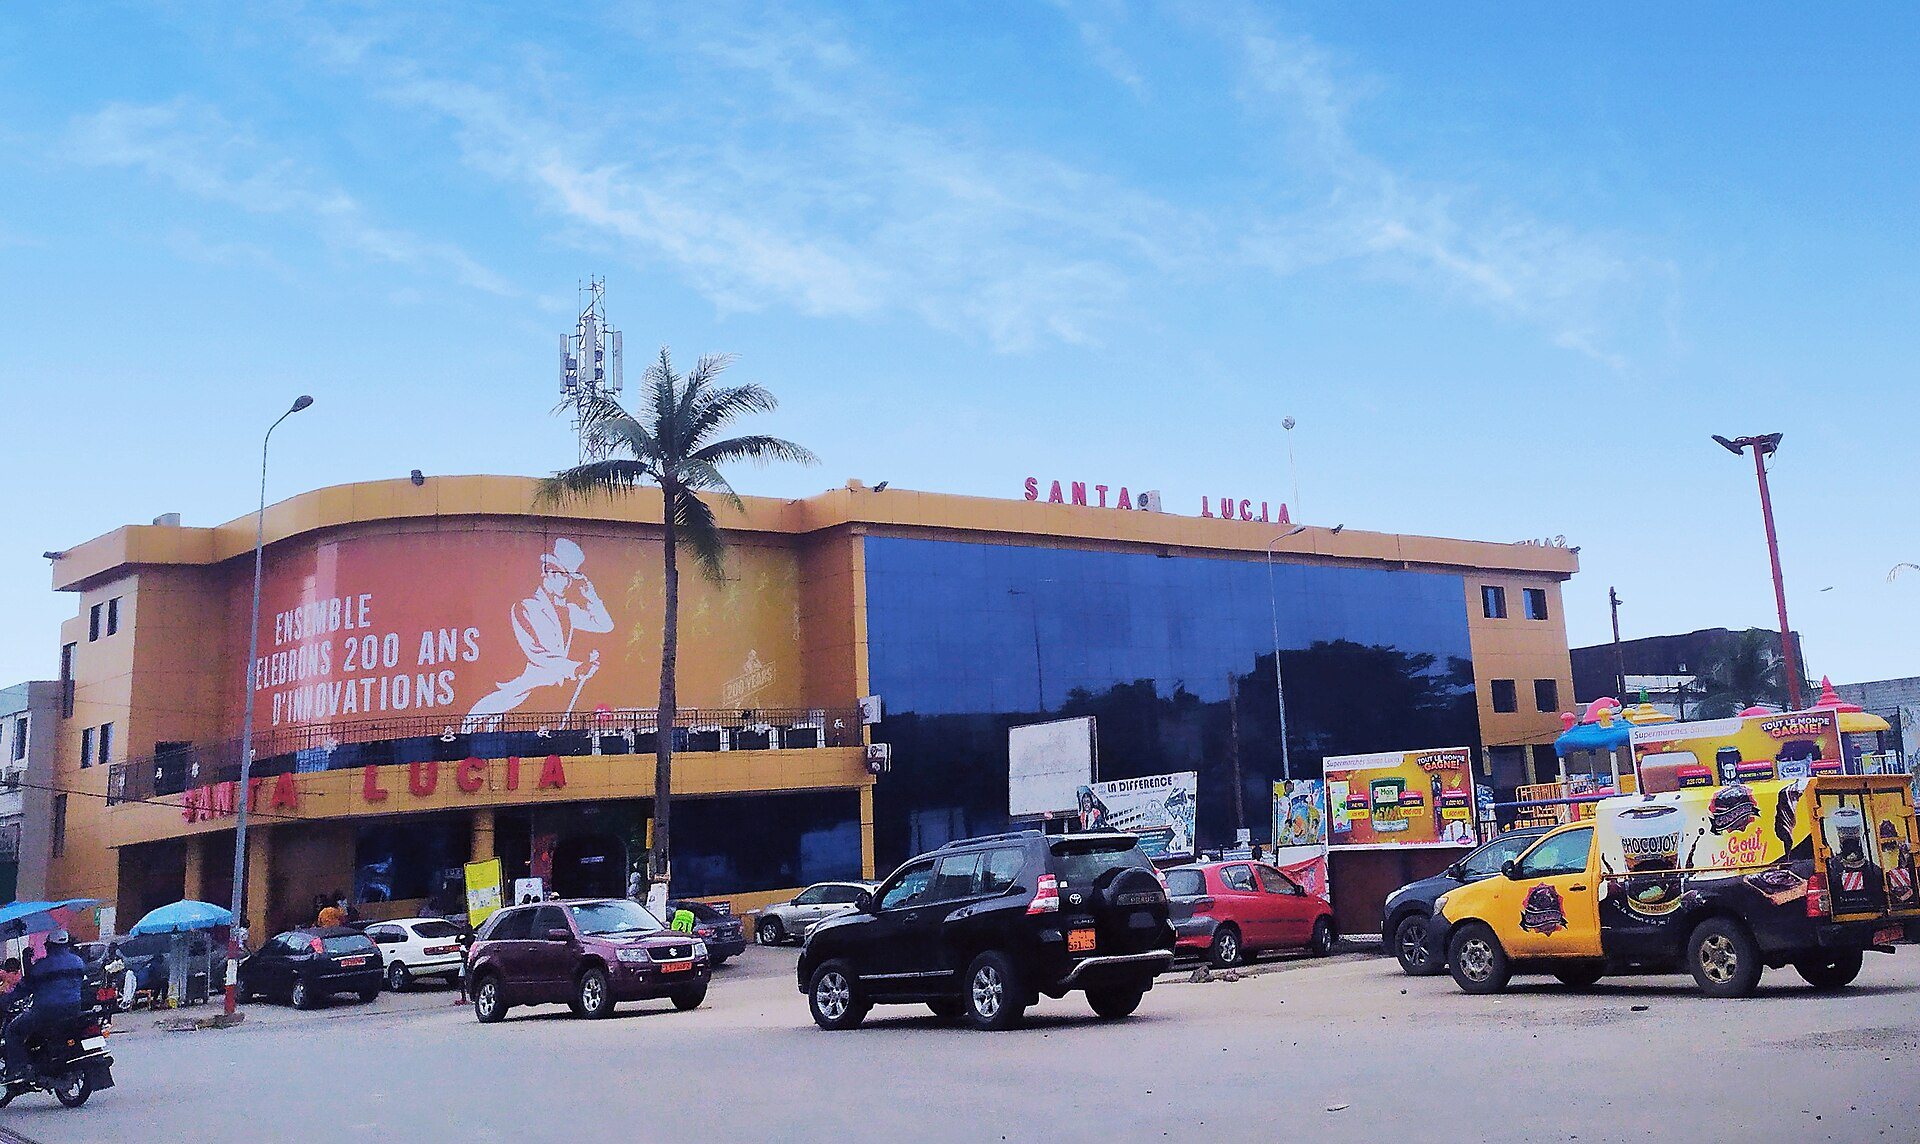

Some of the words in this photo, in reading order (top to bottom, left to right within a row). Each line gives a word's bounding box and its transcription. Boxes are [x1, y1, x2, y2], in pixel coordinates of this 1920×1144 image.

[1024, 477, 1132, 510] SANTA
[1201, 495, 1291, 524] LUCIA
[275, 593, 372, 646] ENSEMBLE
[247, 640, 332, 691] ELEBRONS
[343, 632, 399, 672] 200
[417, 627, 480, 665] ANS
[272, 669, 455, 726] D'INNOVATIONS
[1762, 720, 1784, 730] TOUT
[1786, 718, 1797, 726] LE
[1797, 716, 1830, 726] MONDE
[1771, 723, 1822, 738] GAGNE!
[1417, 755, 1433, 766] TOUT
[1434, 754, 1443, 762] LE
[1424, 760, 1460, 770] GAGNE!
[363, 754, 566, 802] LUCIA
[1107, 783, 1117, 793] LA
[1119, 776, 1173, 792] DIFFERENCE
